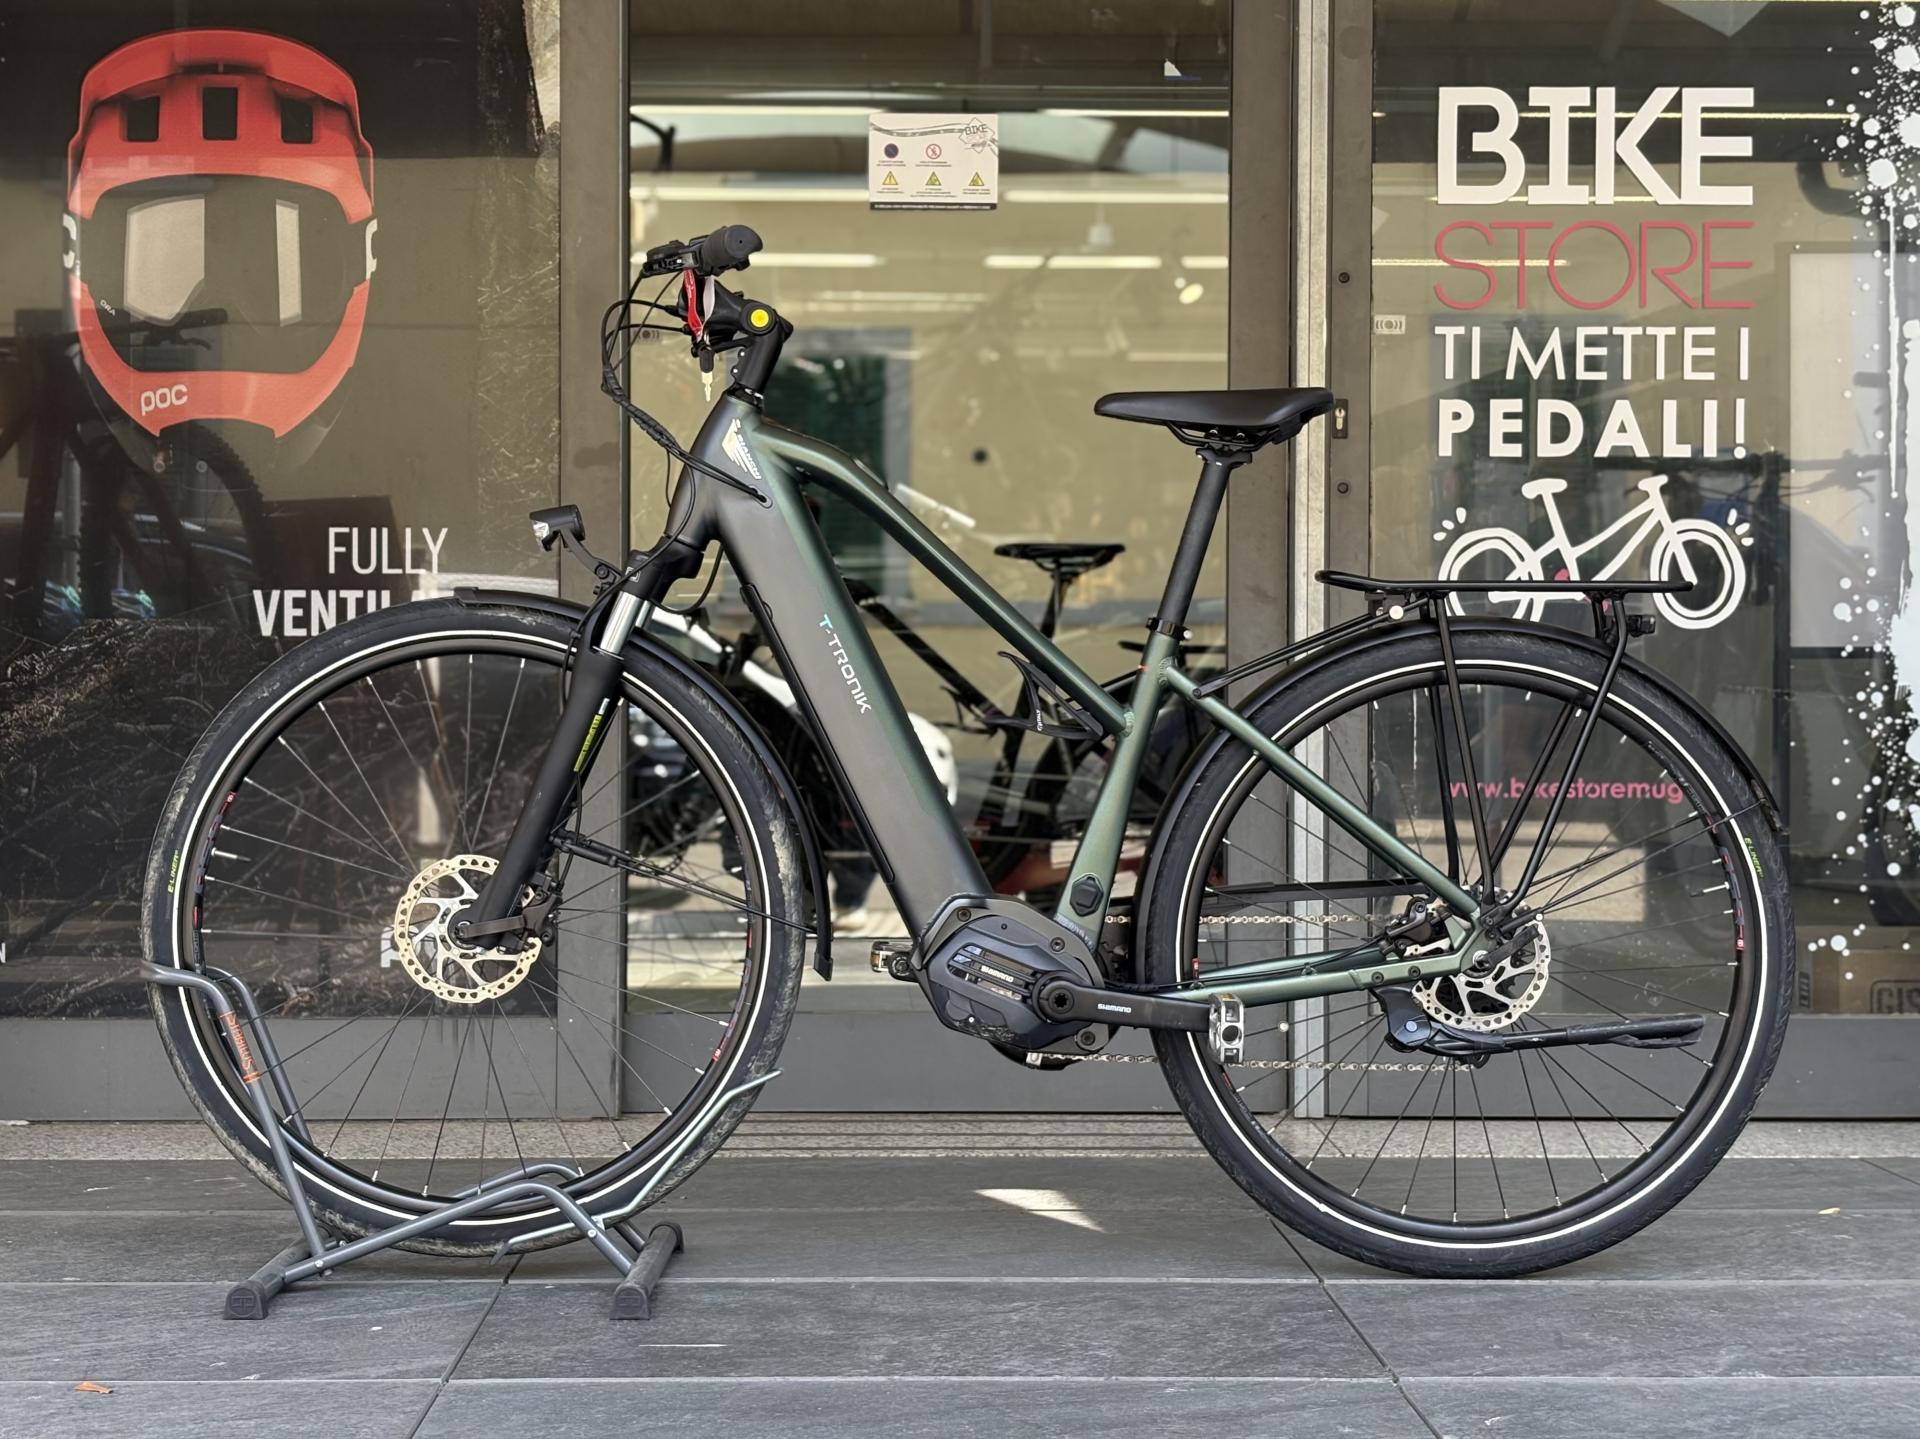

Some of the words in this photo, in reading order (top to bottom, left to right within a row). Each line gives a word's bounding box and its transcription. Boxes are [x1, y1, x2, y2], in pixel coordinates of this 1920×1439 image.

[964, 123, 987, 135] BIKE
[1437, 86, 1755, 206] BIKE
[1433, 220, 1755, 310] STORE
[1434, 326, 1481, 381] TI
[1505, 326, 1717, 381] METTE
[1739, 327, 1750, 381] I
[1438, 398, 1748, 460] PEDALI!
[328, 526, 449, 575] FULLY
[819, 613, 872, 714] T-TRONIK
[980, 964, 1014, 983] SHIMANO
[1097, 1003, 1132, 1013] SHIMANO
